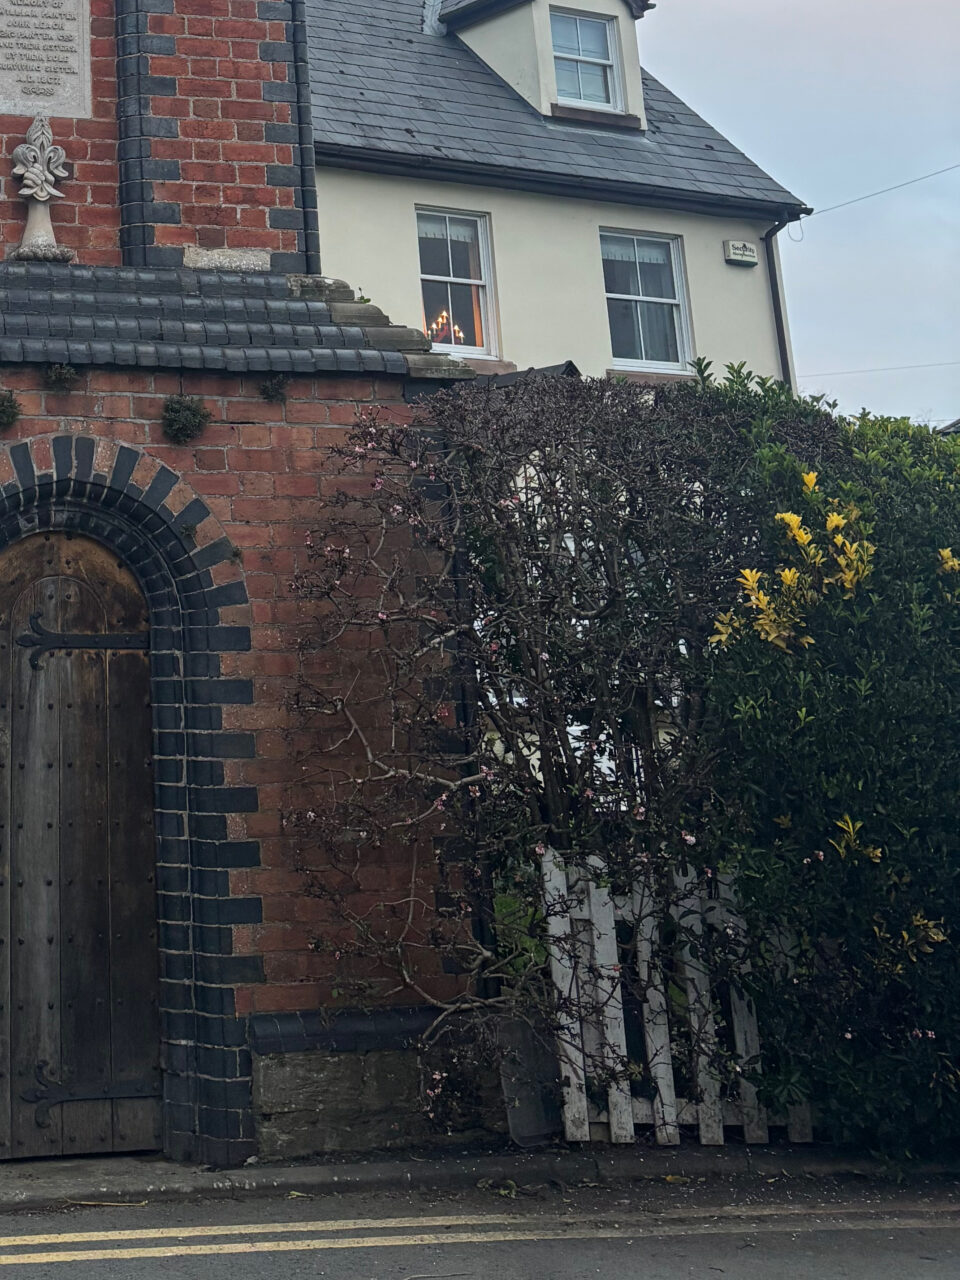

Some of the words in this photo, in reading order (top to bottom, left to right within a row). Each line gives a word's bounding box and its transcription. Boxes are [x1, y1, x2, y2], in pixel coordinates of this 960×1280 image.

[10, 0, 49, 8] MEMORY
[52, 0, 65, 9] OF
[6, 20, 31, 29] JOHN
[16, 42, 41, 51] THEIR
[19, 53, 45, 62] THEIR
